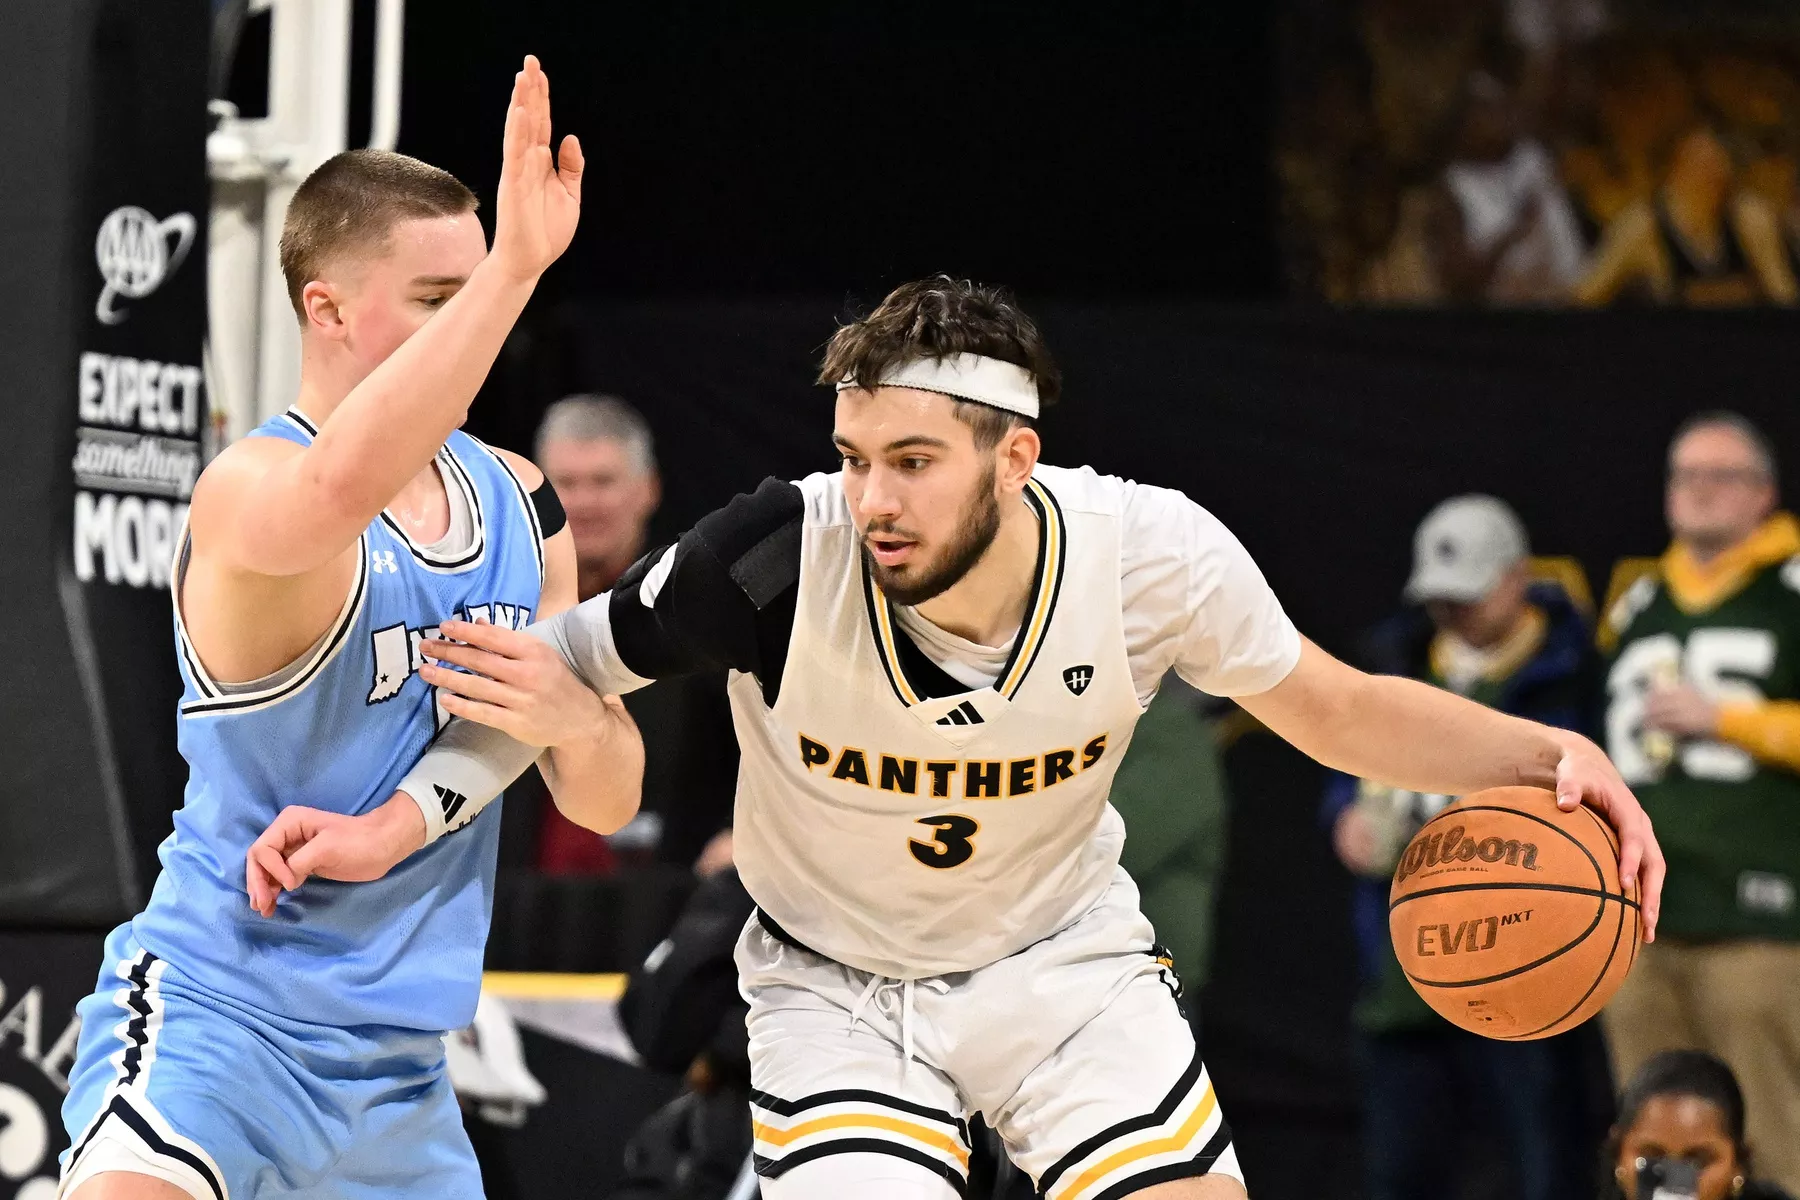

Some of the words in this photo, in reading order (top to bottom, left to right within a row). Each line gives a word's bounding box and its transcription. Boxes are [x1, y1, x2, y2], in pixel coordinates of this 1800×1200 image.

[79, 351, 200, 436] EXPECT
[72, 434, 200, 498] something
[798, 731, 1109, 800] PANTHERS
[907, 812, 981, 870] 3
[1417, 916, 1498, 957] EVO
[1501, 909, 1534, 926] NXT
